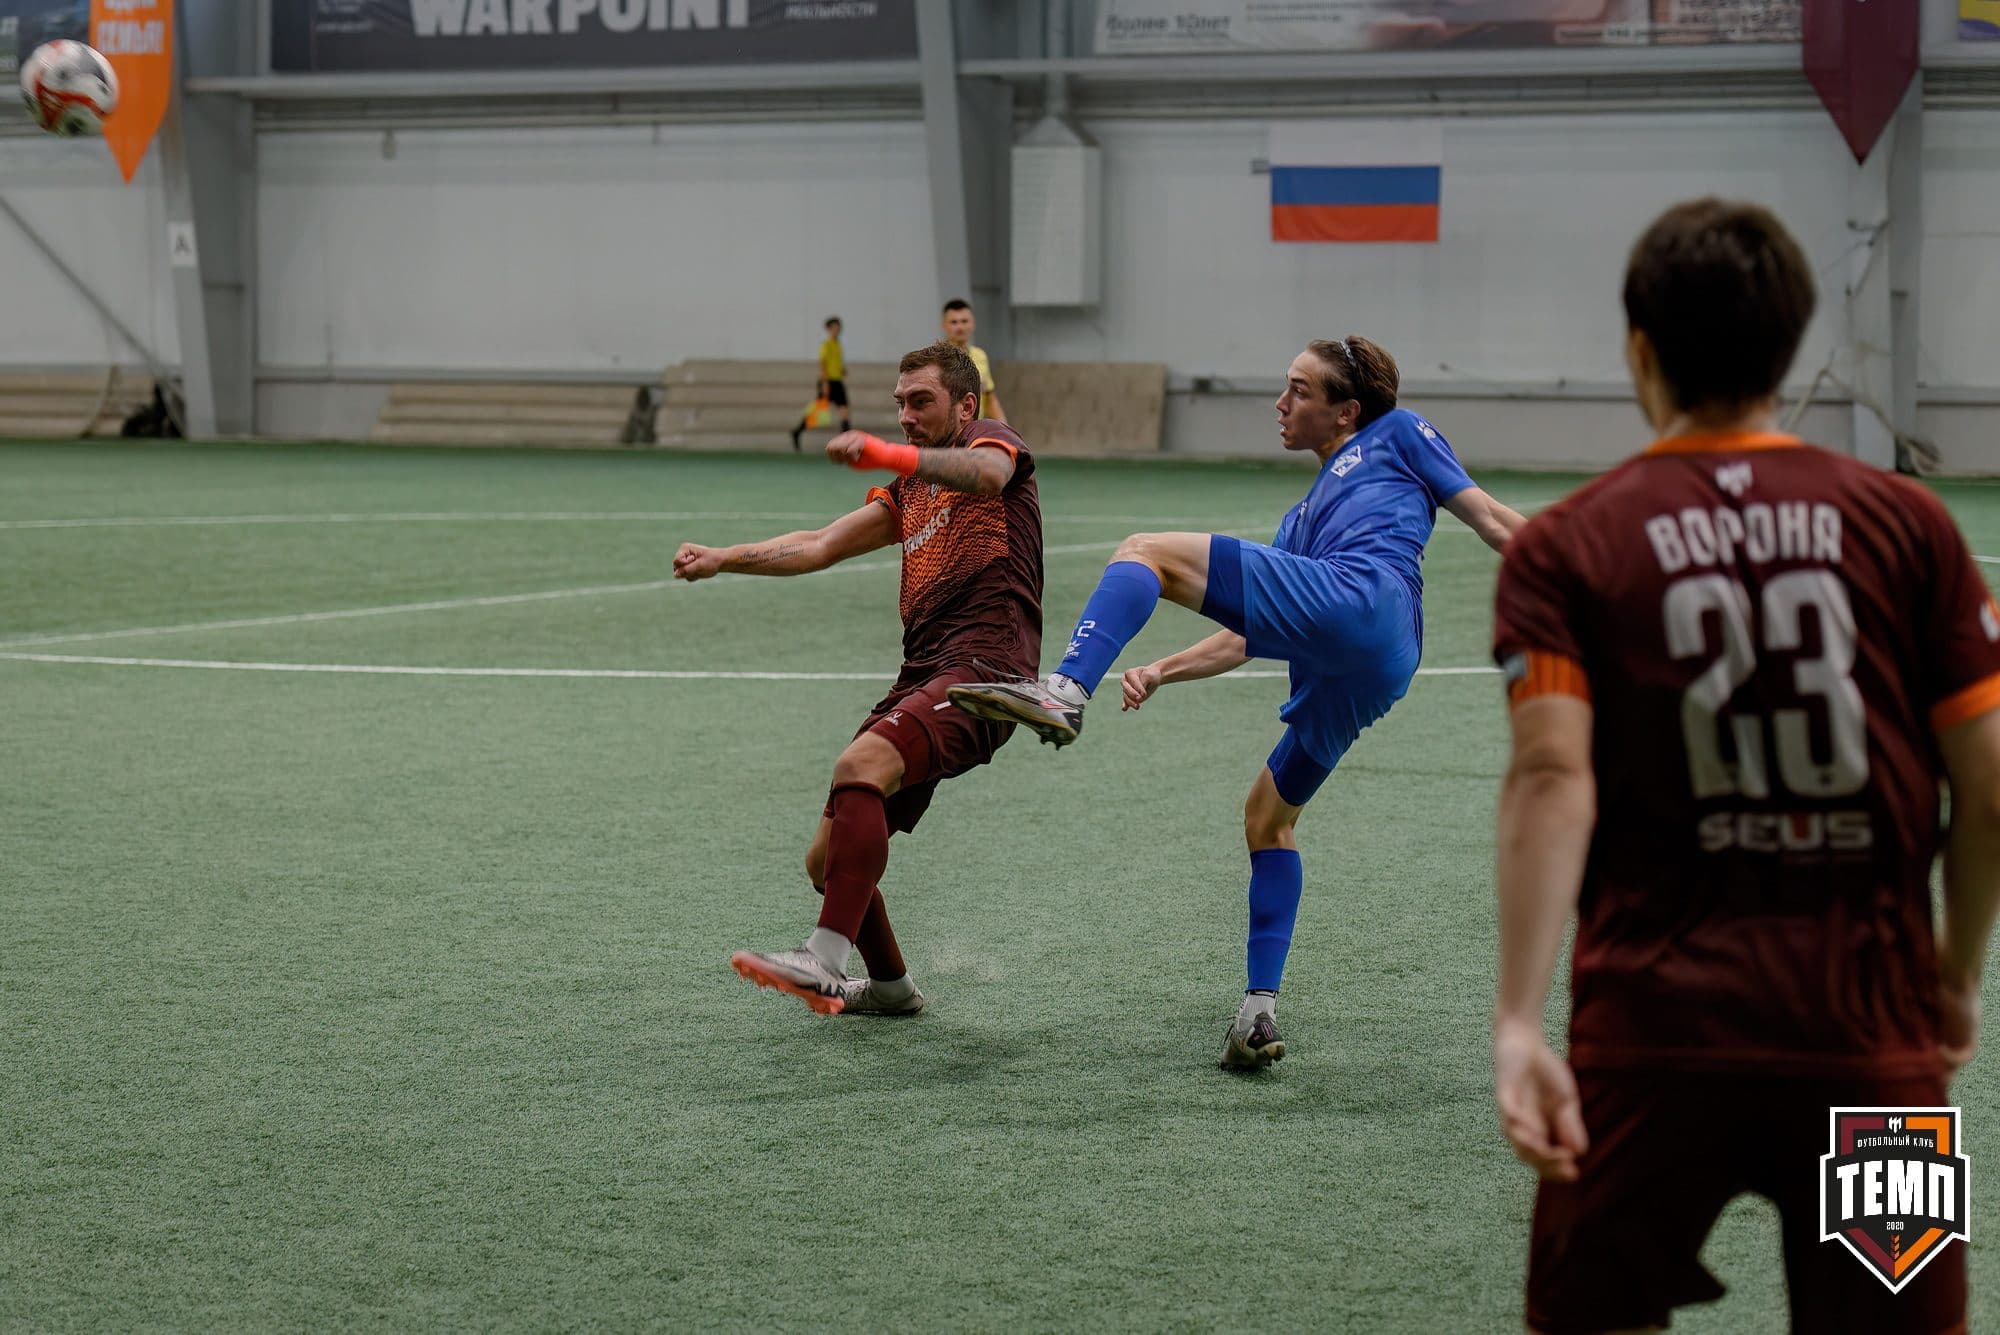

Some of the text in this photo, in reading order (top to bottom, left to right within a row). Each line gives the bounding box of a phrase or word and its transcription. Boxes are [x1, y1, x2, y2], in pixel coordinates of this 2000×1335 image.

[1645, 502, 1843, 574] ВОРОНА
[1076, 620, 1096, 638] 2
[1662, 568, 1870, 799] 23
[1697, 811, 1873, 852] SEUS
